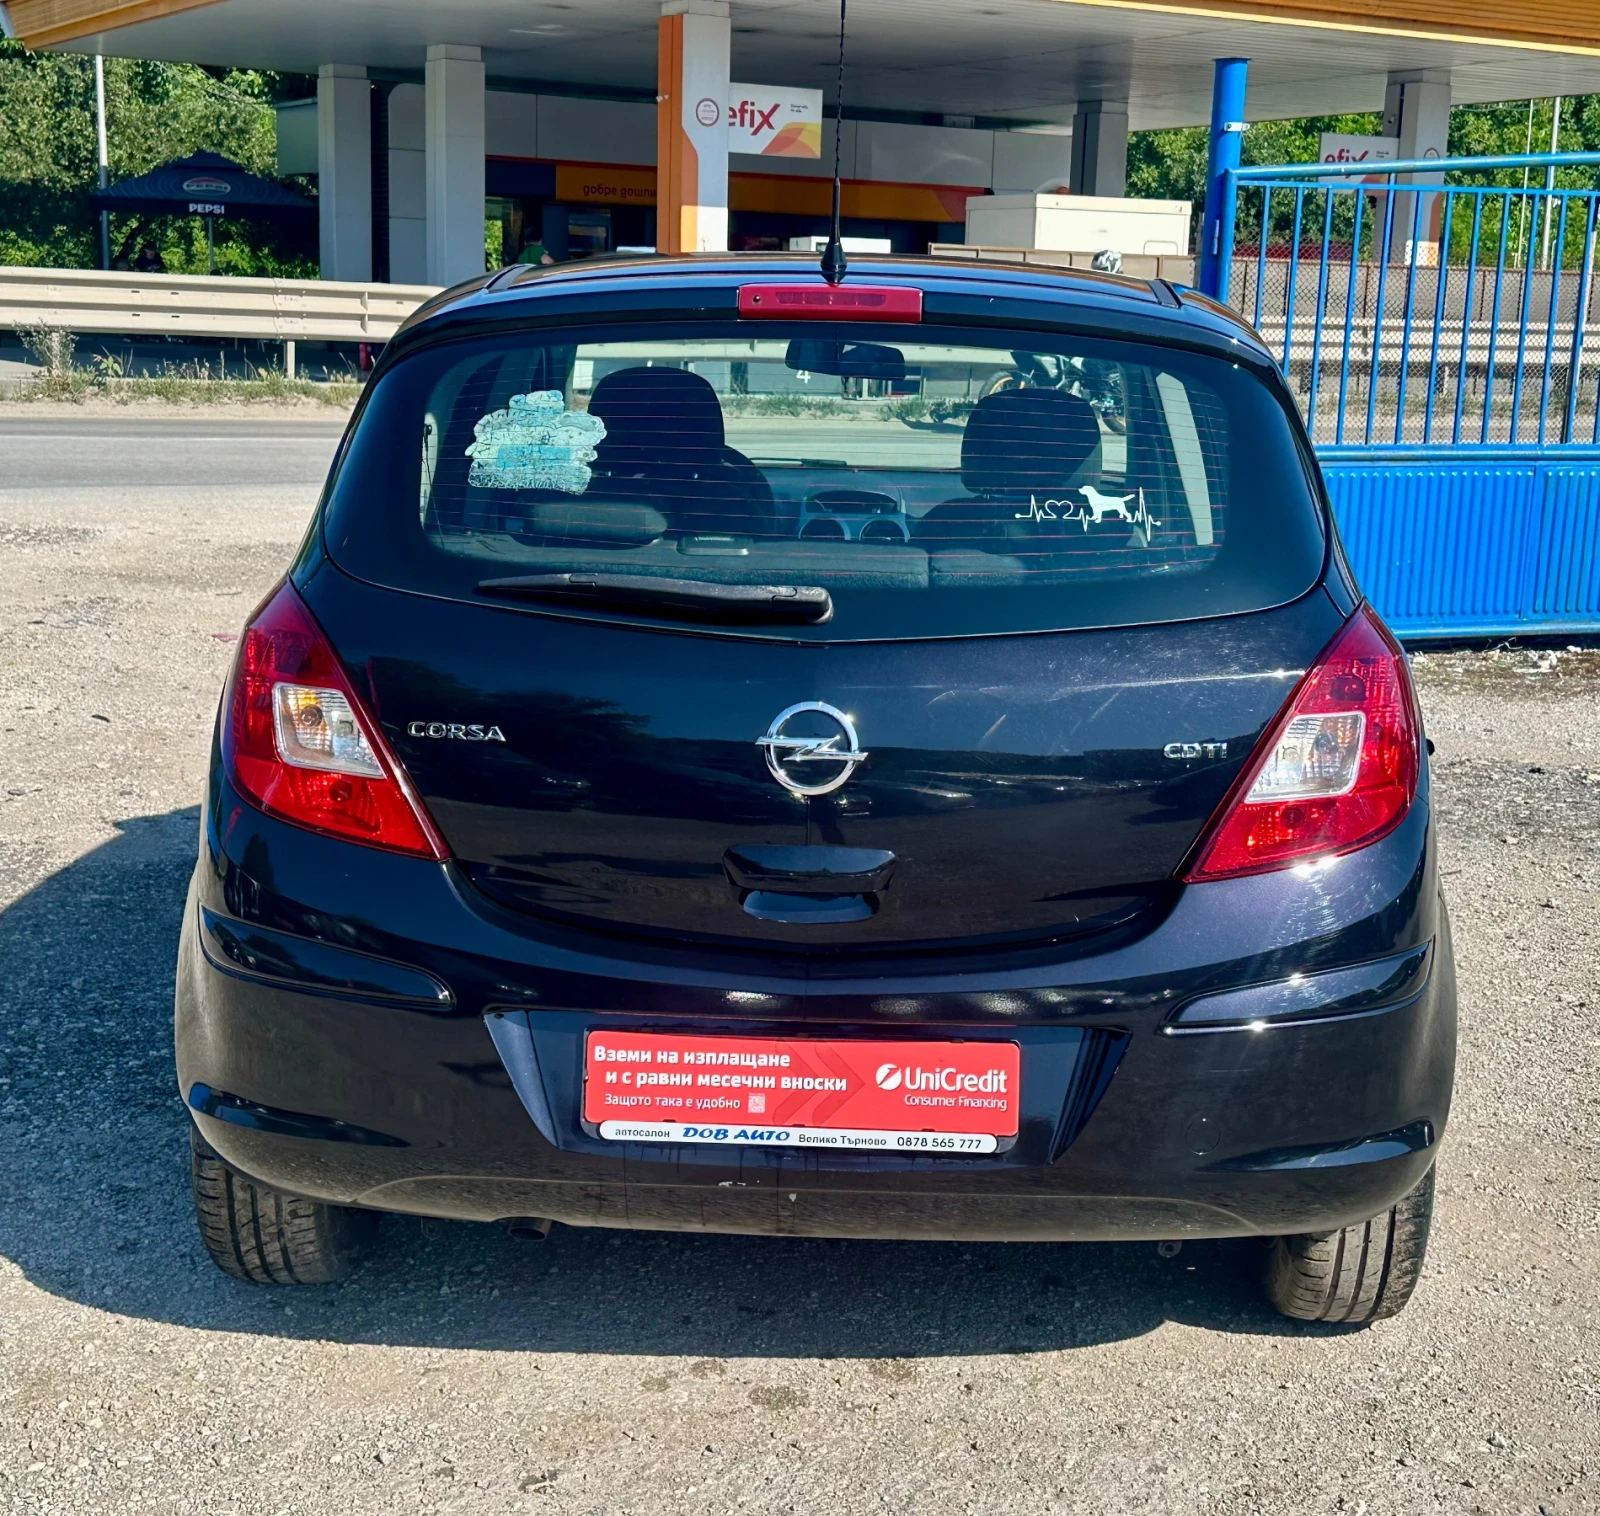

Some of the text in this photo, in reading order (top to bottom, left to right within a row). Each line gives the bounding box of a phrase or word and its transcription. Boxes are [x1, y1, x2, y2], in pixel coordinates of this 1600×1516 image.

[728, 100, 781, 136] efix
[189, 203, 225, 215] PEPSI
[407, 721, 506, 742] CORSA
[1163, 742, 1228, 759] CDTI
[595, 1046, 790, 1069] Вземи на изплащане
[606, 1071, 847, 1091] и с равни месечни вноски
[905, 1067, 1008, 1093] UniCredit
[605, 1093, 740, 1109] Защото така е удобно
[904, 1094, 1007, 1111] Consumer Financing
[615, 1127, 981, 1149] автосалон DOB AUTO Велико Търново 0878 565 777
